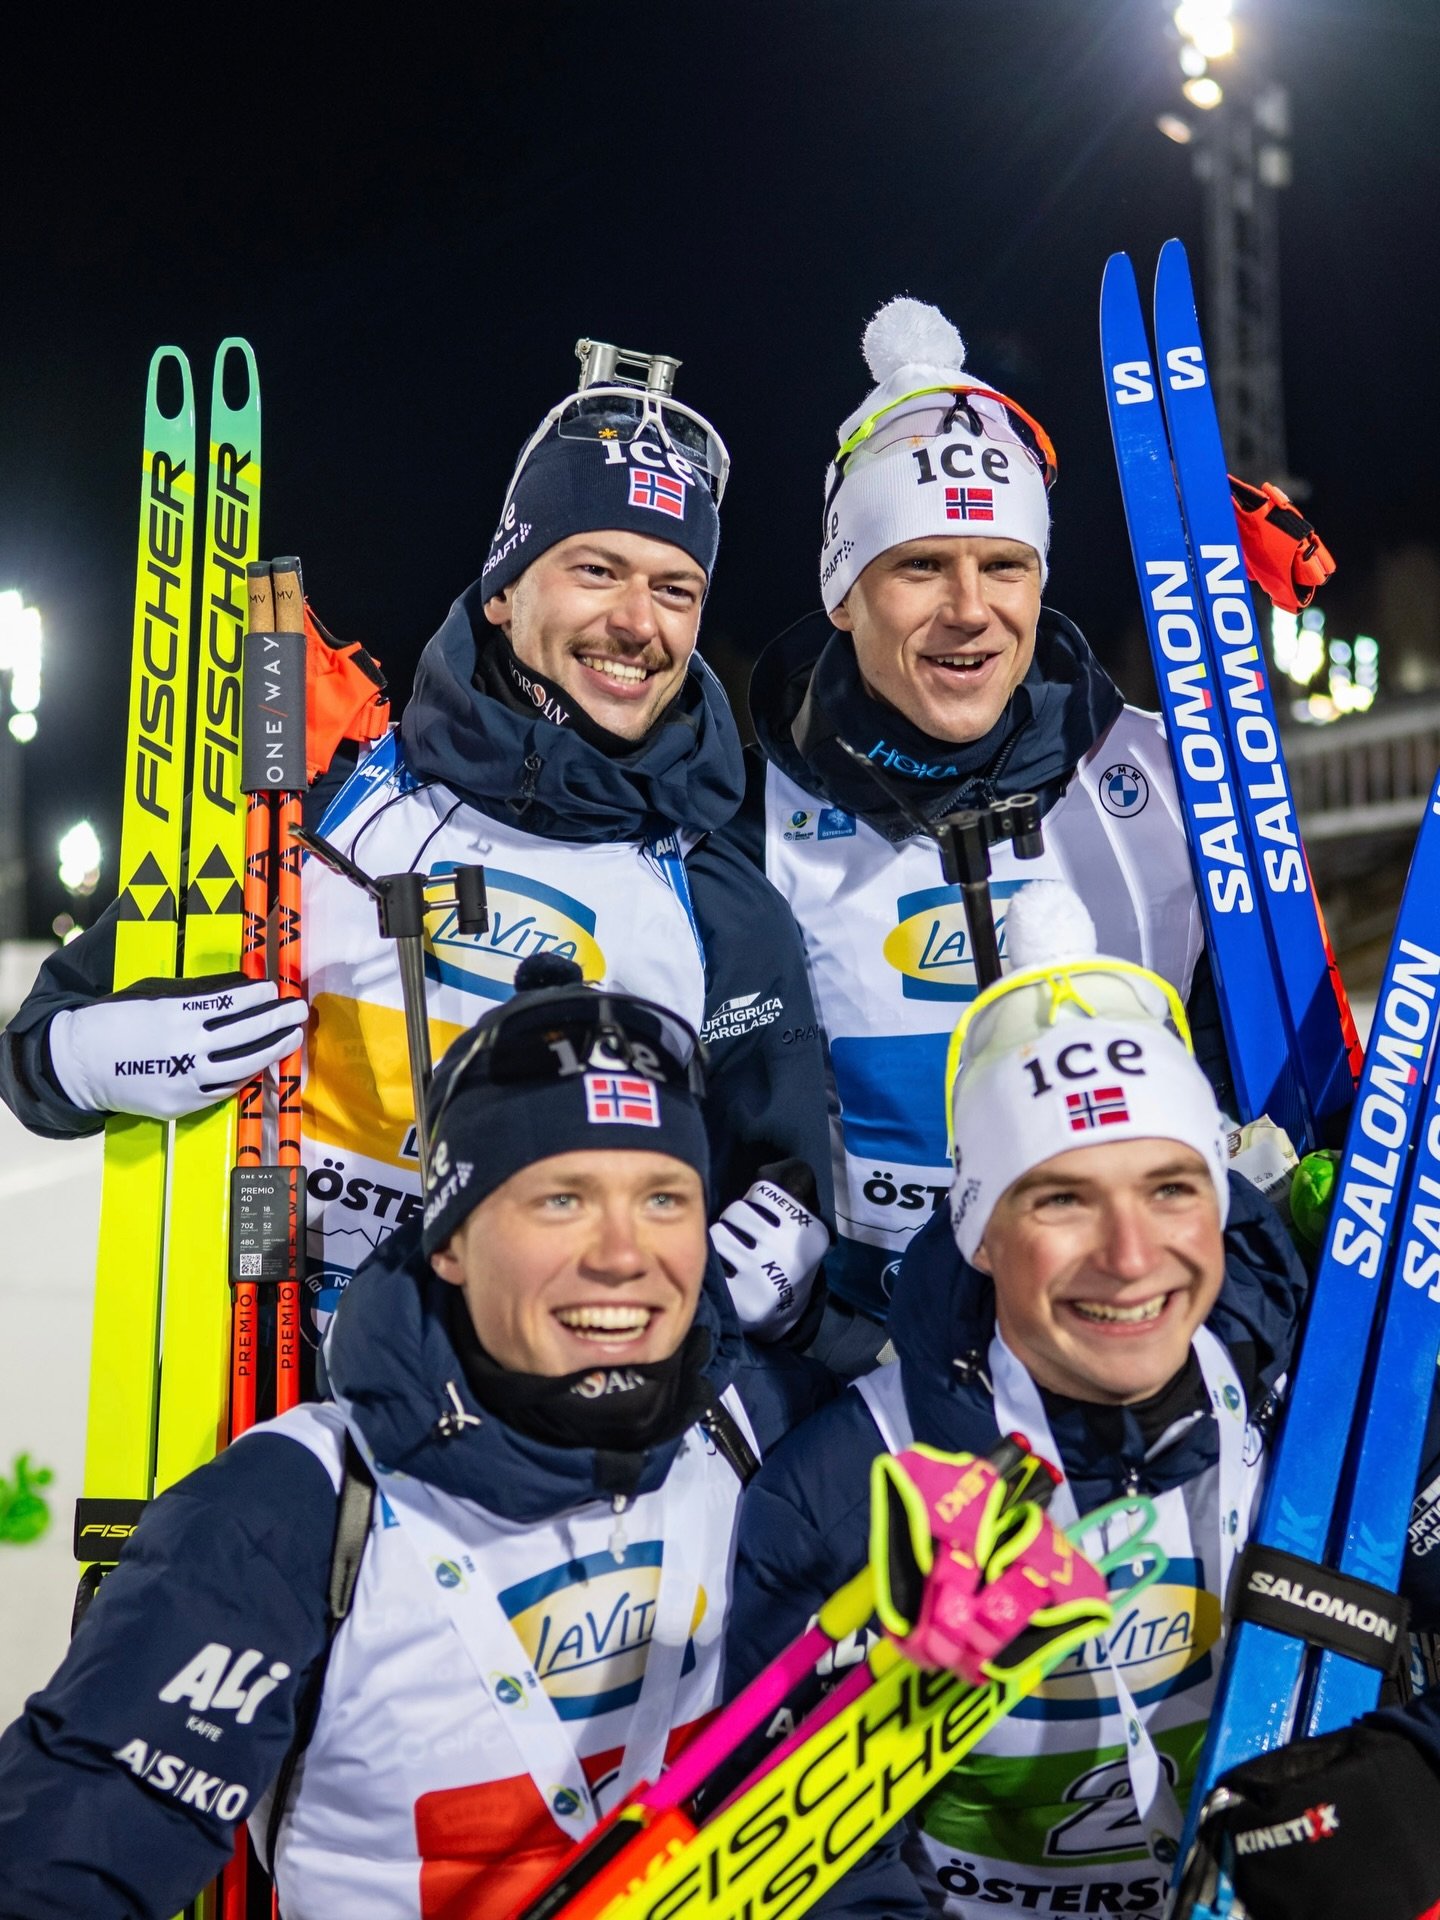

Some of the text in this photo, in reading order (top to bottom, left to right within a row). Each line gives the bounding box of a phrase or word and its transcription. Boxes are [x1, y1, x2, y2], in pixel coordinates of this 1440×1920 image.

[1112, 361, 1154, 405] S
[1167, 346, 1206, 390] S
[912, 443, 1010, 486] ice
[482, 532, 519, 578] CRAFT
[822, 548, 843, 587] CRAFT
[136, 451, 186, 823] FISCHER
[203, 442, 252, 815] FISCHER
[1146, 561, 1253, 914] SALOMON
[1200, 545, 1306, 893] SALOMON
[868, 741, 958, 779] HOKA
[1105, 766, 1141, 781] BMW
[701, 998, 784, 1032] URTIGRUTA
[1332, 938, 1440, 1280] SALOMON
[238, 1294, 252, 1376] PREMIO
[281, 1287, 295, 1369] PREMIO
[1247, 1570, 1398, 1643] SALOMON
[186, 1715, 224, 1743] KAFFE
[645, 1666, 958, 1920] FISCHE
[1046, 1748, 1178, 1858] 2
[937, 1858, 1166, 1913] ÖSTERS
